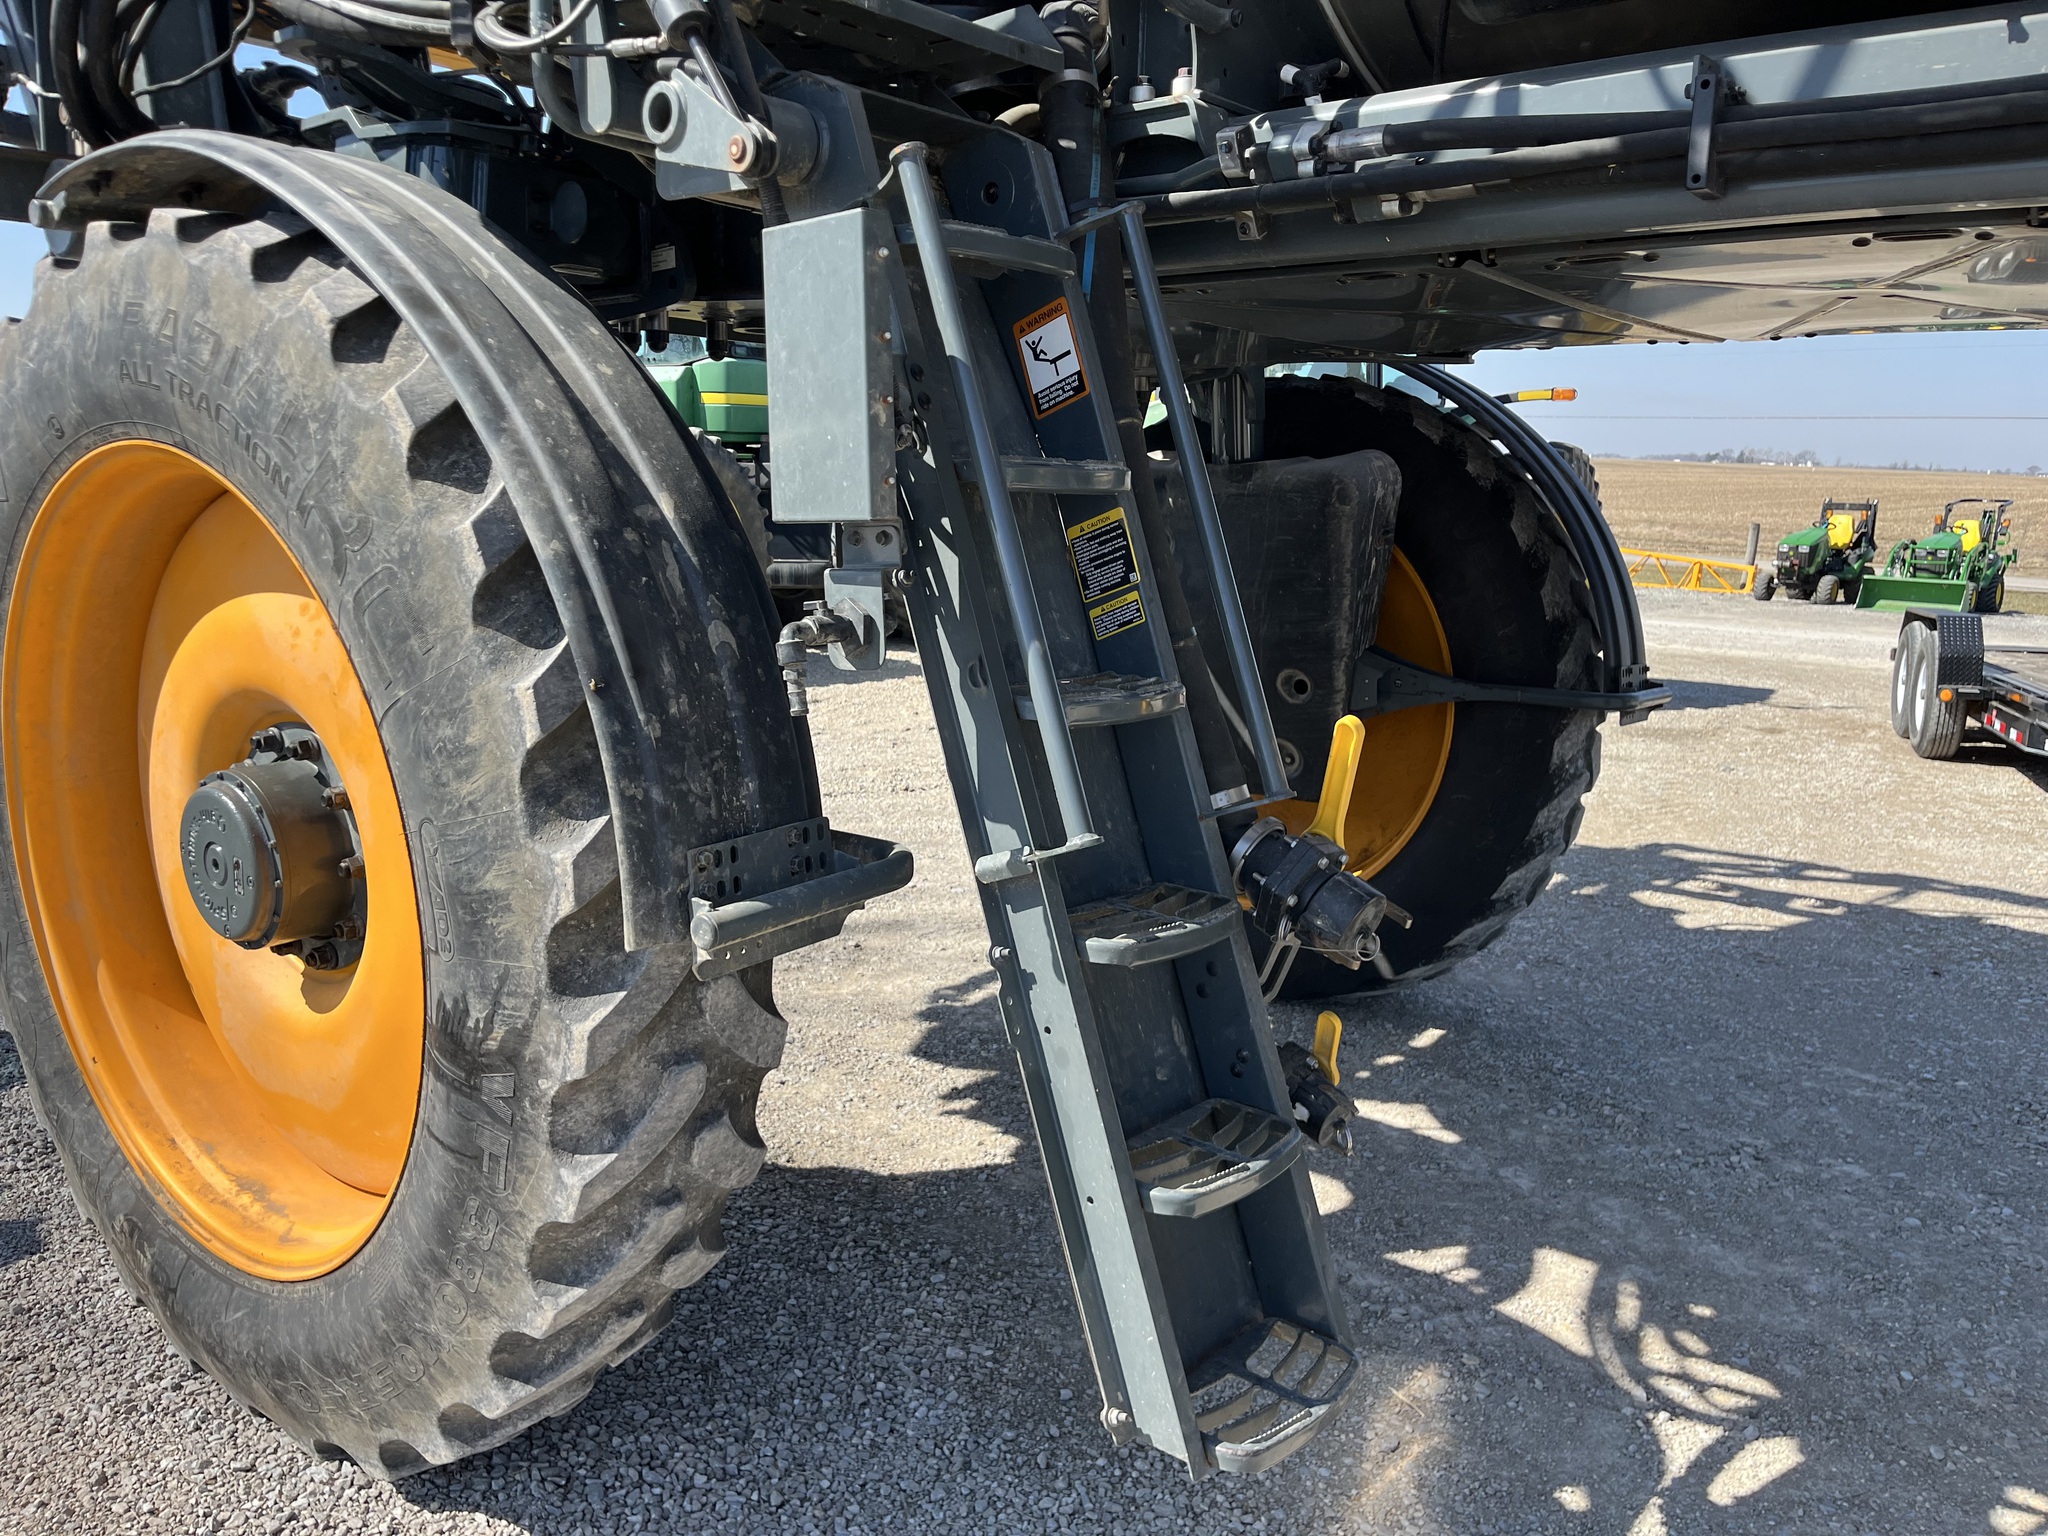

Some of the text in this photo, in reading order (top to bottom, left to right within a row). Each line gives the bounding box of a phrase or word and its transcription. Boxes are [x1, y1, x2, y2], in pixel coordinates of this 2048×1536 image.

[1025, 302, 1064, 330] WARNING
[1037, 375, 1079, 397] Avoid serious injury
[119, 358, 293, 499] ALL TRACTION
[1086, 515, 1111, 529] CAUTION
[1105, 597, 1129, 610] CAUTION
[474, 1073, 517, 1195] VF
